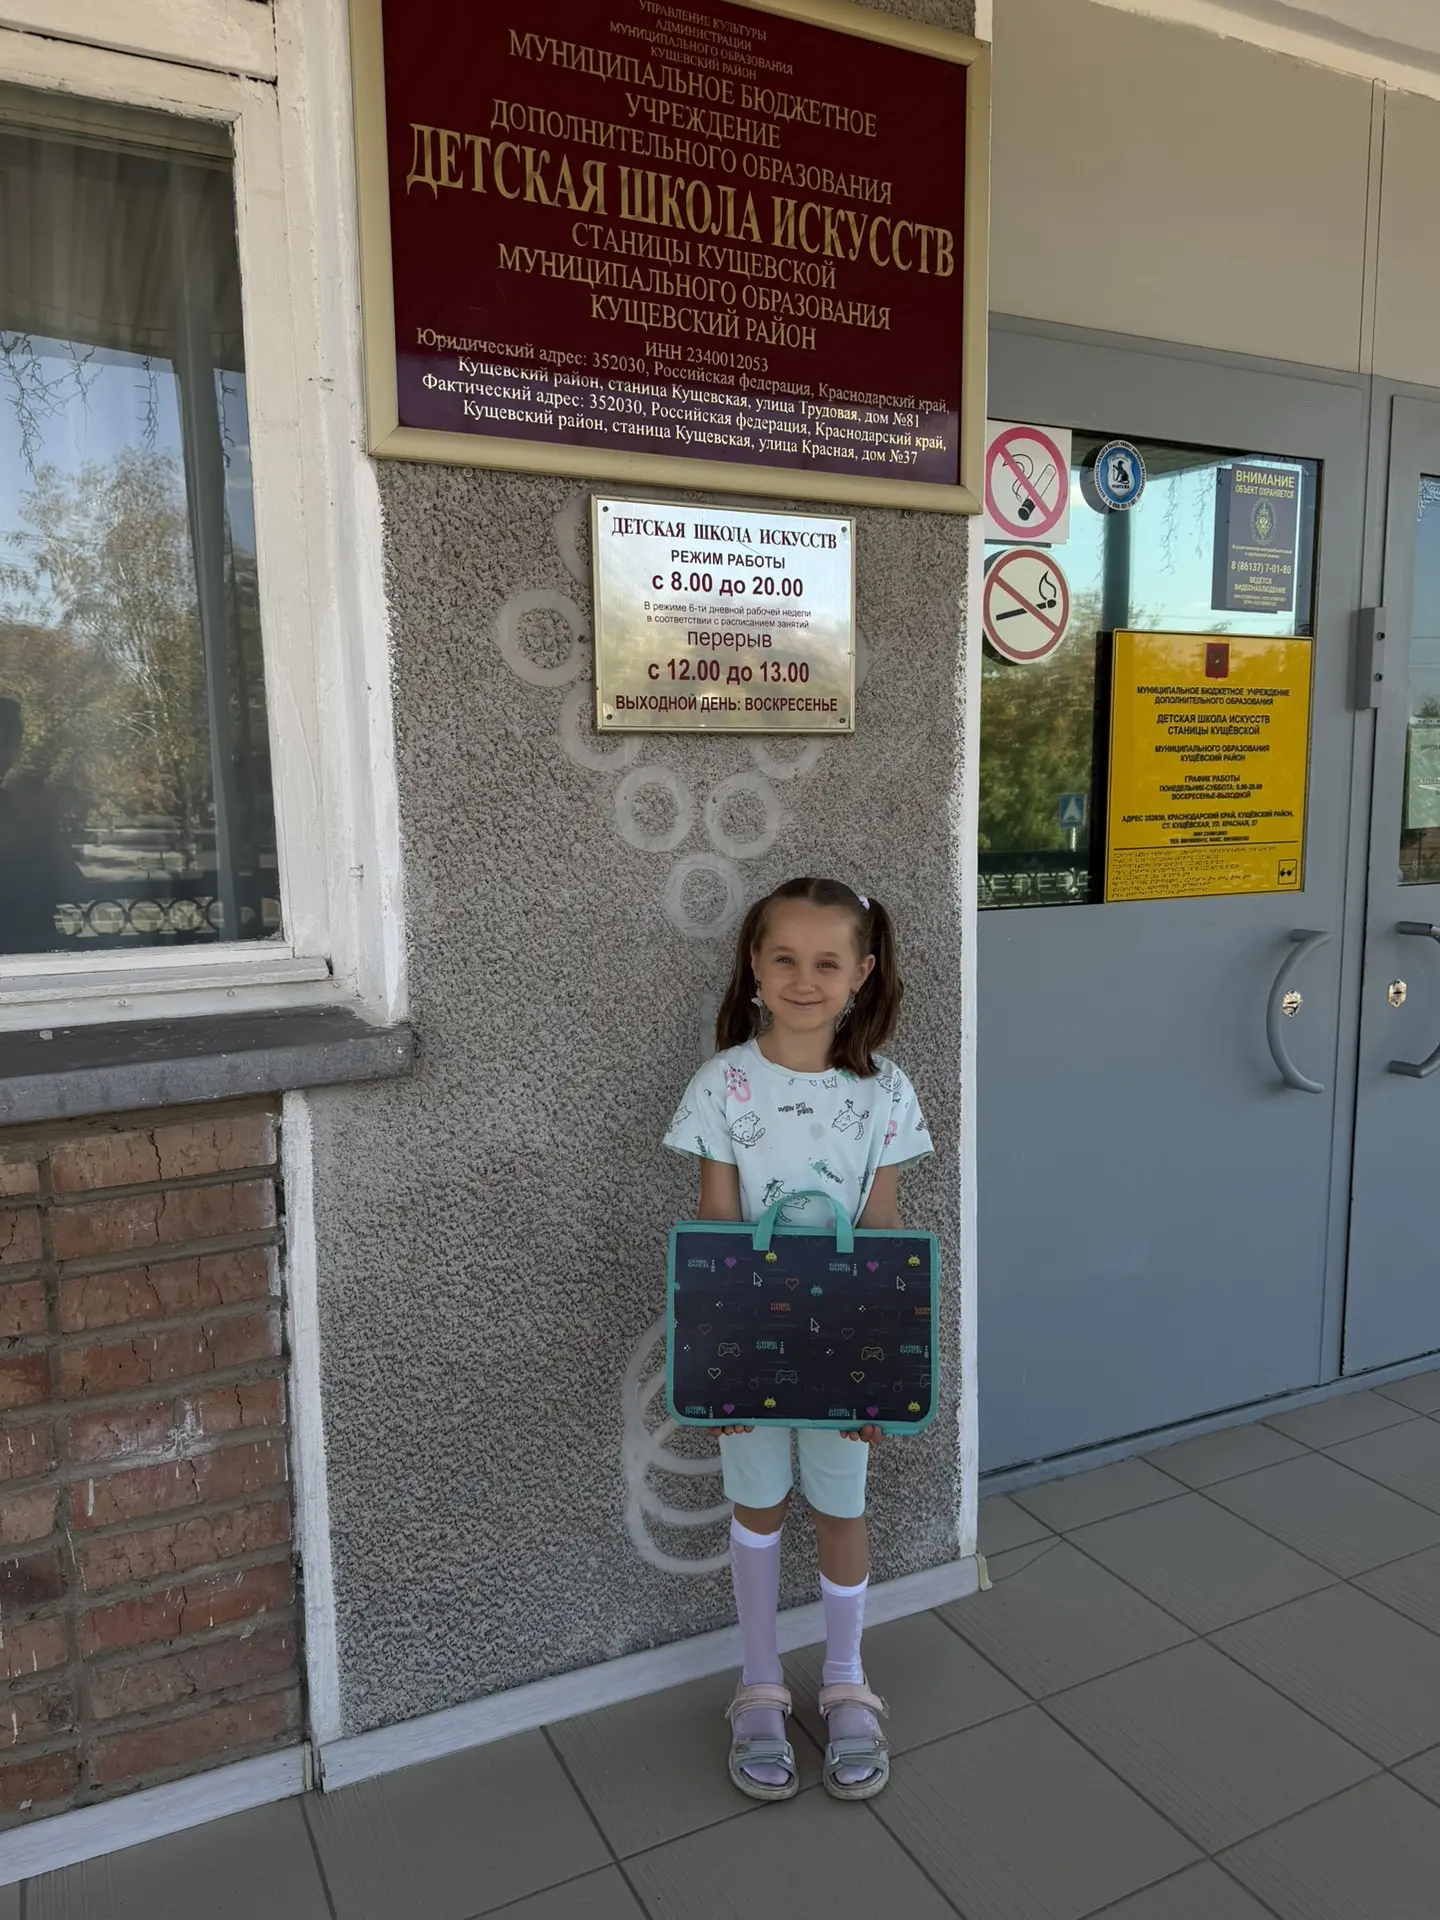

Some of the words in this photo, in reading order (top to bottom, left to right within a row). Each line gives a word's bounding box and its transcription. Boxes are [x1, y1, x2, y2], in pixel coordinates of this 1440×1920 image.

[639, 0, 711, 27] УПРАВЛЕНИЕ
[712, 18, 767, 41] КУЛЬТУРЫ
[610, 21, 719, 57] МУНИЦИПАЛЬНОГО
[720, 48, 793, 75] ОБРАЗОВАНИЯ
[655, 20, 752, 51] АДМИНИСТРАЦИИ
[650, 46, 720, 72] КУЩЕВСКИЙ
[722, 62, 757, 80] РАЙОН
[508, 28, 735, 105] МУНИЦИПАЛЬНОЕ
[741, 83, 877, 138] БЮДЖЕТНОЕ
[624, 92, 782, 149] УЧРЕЖДЕНИЕ
[490, 98, 737, 173] ДОПОЛНИТЕЛЬНОГО
[742, 153, 893, 205] ОБРАЗОВАНИЯ
[406, 122, 608, 216] ДЕТСКАЯ
[618, 165, 763, 244] ШКОЛА
[771, 195, 954, 277] ИСКУССТВ
[571, 222, 691, 267] СТАНИЦЫ
[697, 242, 837, 290] КУЩЕВСКОЙ
[496, 242, 737, 305] МУНИЦИПАЛЬНОГО
[742, 284, 892, 331] ОБРАЗОВАНИЯ
[590, 294, 740, 339] КУЩЕВСКИЙ
[745, 315, 817, 350] РАЙОН
[645, 341, 682, 361] ИНН
[687, 347, 769, 373] 2340012053
[416, 327, 535, 359] Юридический
[539, 349, 587, 368] адрес:
[592, 352, 650, 377] 352030,
[654, 361, 735, 386] Российская
[739, 373, 815, 398] федерация,
[818, 383, 916, 409] Краснодарский
[918, 398, 951, 415] край,
[458, 356, 549, 383] Кущевский
[554, 370, 604, 392] район,
[608, 379, 667, 398] станица
[672, 384, 752, 410] Кущевская,
[756, 397, 795, 414] улица
[799, 400, 862, 423] Трудовая,
[864, 411, 889, 425] дом
[892, 412, 920, 428] №81
[422, 373, 532, 402] Фактический
[536, 390, 584, 408] адрес:
[589, 393, 647, 418] 352030,
[651, 401, 732, 426] Российская
[735, 412, 812, 436] федерация,
[815, 422, 912, 446] Краснодарский
[915, 435, 947, 452] край,
[463, 399, 554, 425] Кущевский
[558, 413, 608, 433] район,
[612, 420, 671, 439] станица
[675, 424, 755, 450] Кущевская,
[759, 438, 798, 453] улица
[801, 439, 859, 462] Красная,
[861, 449, 886, 463] дом
[889, 448, 918, 465] №37
[1234, 484, 1259, 496] ОБЪЕКТ
[1258, 487, 1296, 499] ОХРАНЯЕТСЯ
[1235, 470, 1295, 489] ВНИМАНИЕ
[611, 516, 686, 539] ДЕТСКАЯ
[693, 523, 752, 544] ШКОЛА
[759, 528, 838, 549] ИСКУССТВ
[670, 549, 723, 566] РЕЖИМ
[727, 552, 786, 569] РАБОТЫ
[1231, 560, 1237, 570] 8
[1236, 560, 1264, 575] (86137)
[1264, 563, 1292, 575] 7-01-80
[670, 571, 713, 592] 8.00
[719, 577, 746, 597] до
[752, 576, 804, 597] 20.00
[1233, 583, 1287, 595] ВИДЕОНАБЛЮДЕНИЕ
[643, 600, 651, 610] В
[652, 603, 687, 615] режиме
[688, 603, 707, 614] 6-ти
[708, 605, 745, 616] дневной
[746, 606, 781, 619] рабочей
[782, 609, 812, 619] недели
[654, 616, 712, 626] соответствии
[720, 618, 775, 629] расписанием
[777, 619, 810, 629] занятий
[687, 630, 772, 651] перерыв
[666, 658, 720, 682] 12.00
[726, 665, 753, 685] до
[759, 661, 810, 683] 13.00
[615, 693, 697, 713] ВЫХОДНОЙ
[700, 696, 741, 713] ДЕНЬ:
[744, 697, 838, 712] ВОСКРЕСЕНЬЕ
[1136, 686, 1200, 695] МУНИЦИПАЛЬНОЕ
[1200, 687, 1244, 696] БЮДЖЕТНОЕ
[1246, 688, 1290, 697] УЧРЕЖДЕНИЕ
[1154, 696, 1224, 705] ДОПОЛНИТЕЛЬНОГО
[1225, 697, 1273, 706] ОБРАЗОВАНИЯ
[1156, 714, 1196, 724] ДЕТСКАЯ
[1197, 714, 1227, 724] ШКОЛА
[1229, 714, 1270, 724] ИСКУССТВ
[1167, 726, 1209, 736] СТАНИЦЫ
[1210, 724, 1260, 736] КУЩЁВСКОЙ
[1154, 744, 1221, 754] МУНИЦИПАЛЬНОГО
[1221, 744, 1270, 753] ОБРАЗОВАНИЯ
[1180, 753, 1222, 763] КУЩЁВСКИЙ
[1223, 753, 1246, 762] РАЙОН
[1184, 775, 1211, 783] ГРАФИК
[1212, 774, 1241, 783] РАБОТЫ
[1167, 811, 1219, 821] КРАСНОДАРСКИЙ
